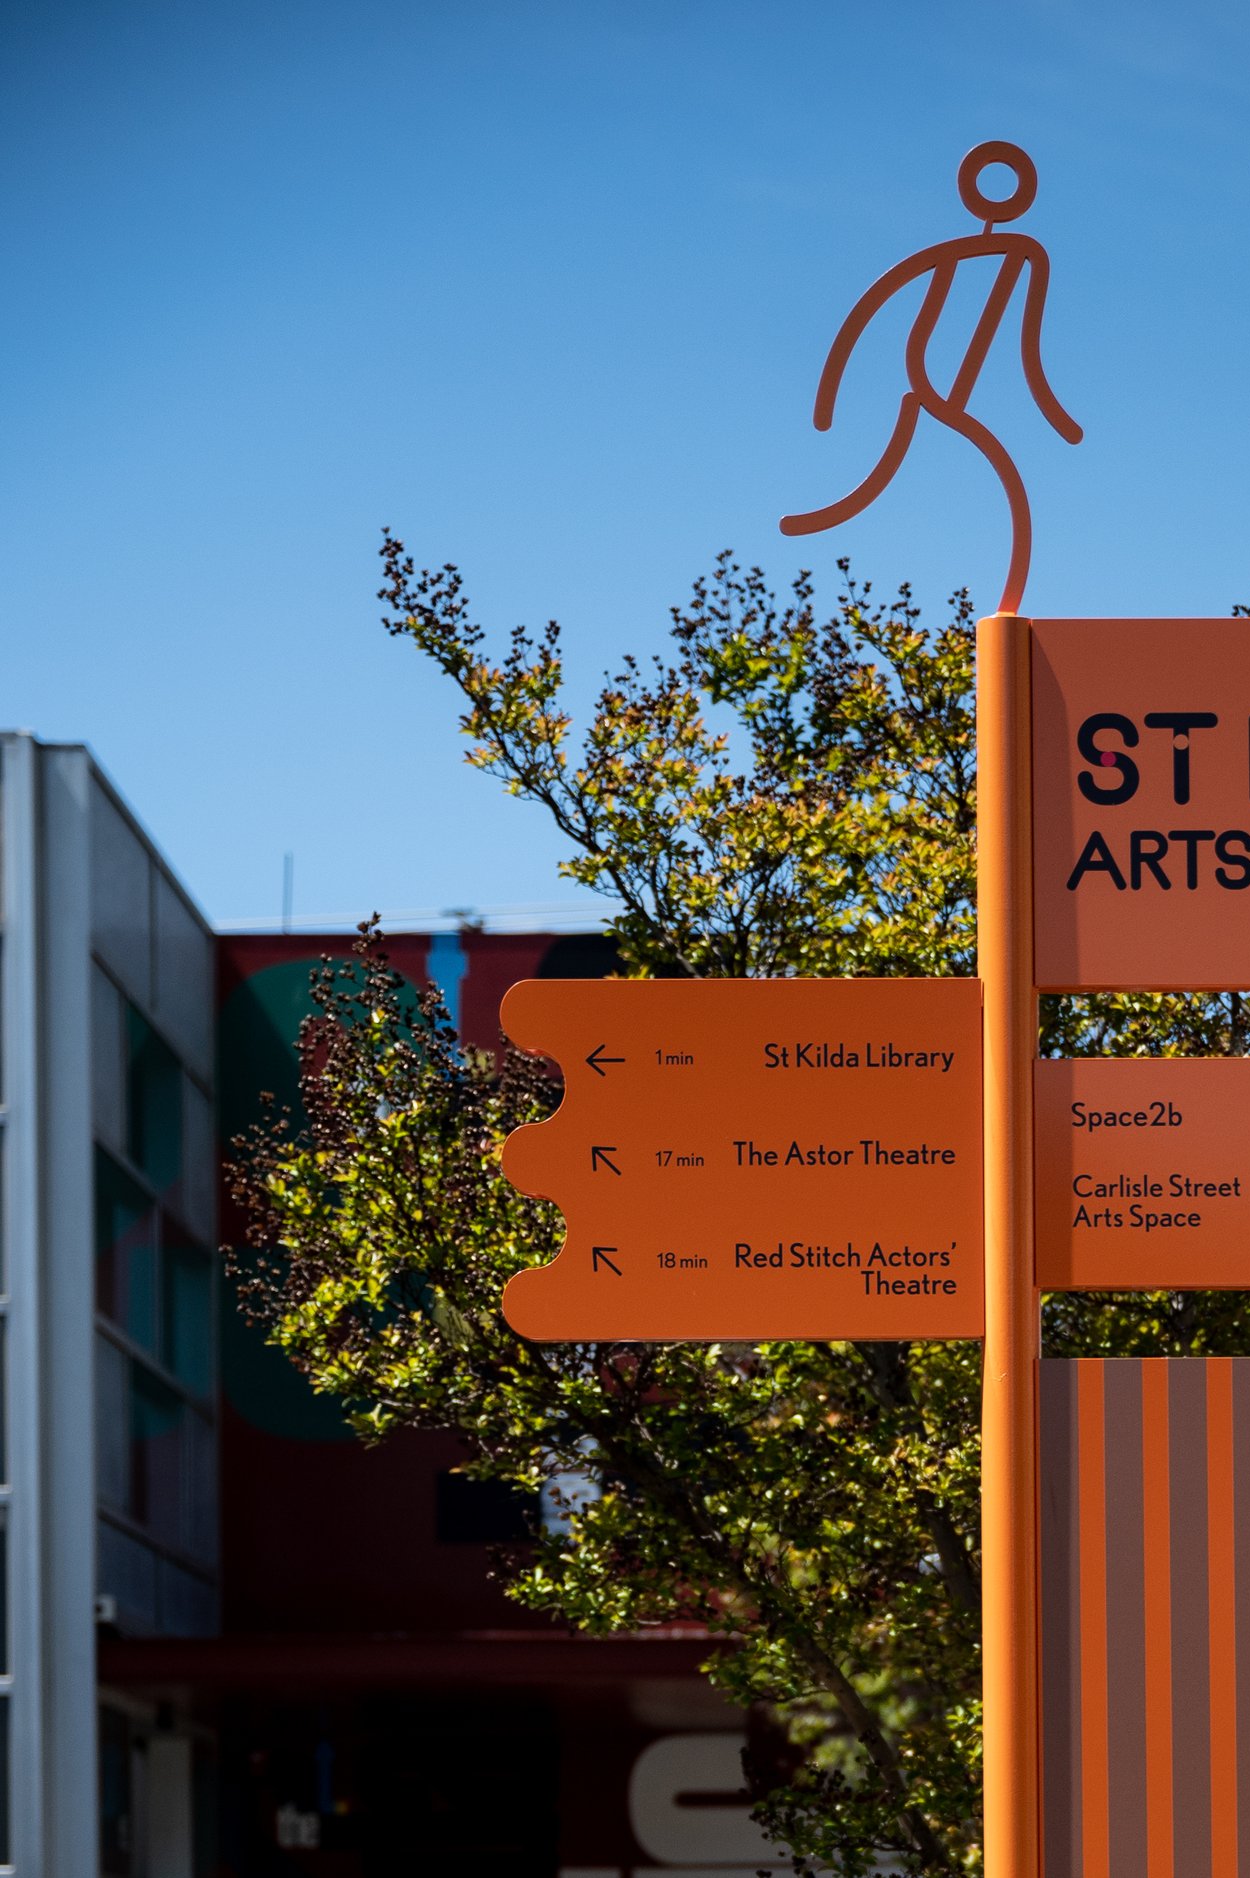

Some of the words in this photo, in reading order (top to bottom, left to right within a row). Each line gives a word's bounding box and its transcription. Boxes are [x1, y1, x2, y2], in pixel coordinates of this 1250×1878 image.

[1077, 711, 1219, 806] ST
[665, 1051, 694, 1066] min
[764, 1042, 790, 1069] St
[796, 1042, 860, 1068] Kilda
[866, 1042, 955, 1073] Library
[1070, 1101, 1183, 1132] Space2b
[655, 1150, 673, 1167] 17
[676, 1152, 705, 1167] min
[732, 1141, 779, 1167] The
[784, 1140, 855, 1167] Astor
[859, 1140, 956, 1166] Theatre
[1072, 1174, 1163, 1198] Carlisle
[1169, 1173, 1241, 1198] Street
[1072, 1204, 1124, 1228] Arts
[1129, 1203, 1201, 1233] Space
[656, 1252, 676, 1269] 18
[679, 1254, 708, 1269] min
[735, 1242, 783, 1268] Red
[789, 1242, 861, 1268] Stitch
[866, 1242, 957, 1268] Actors'
[860, 1270, 957, 1295] Theatre
